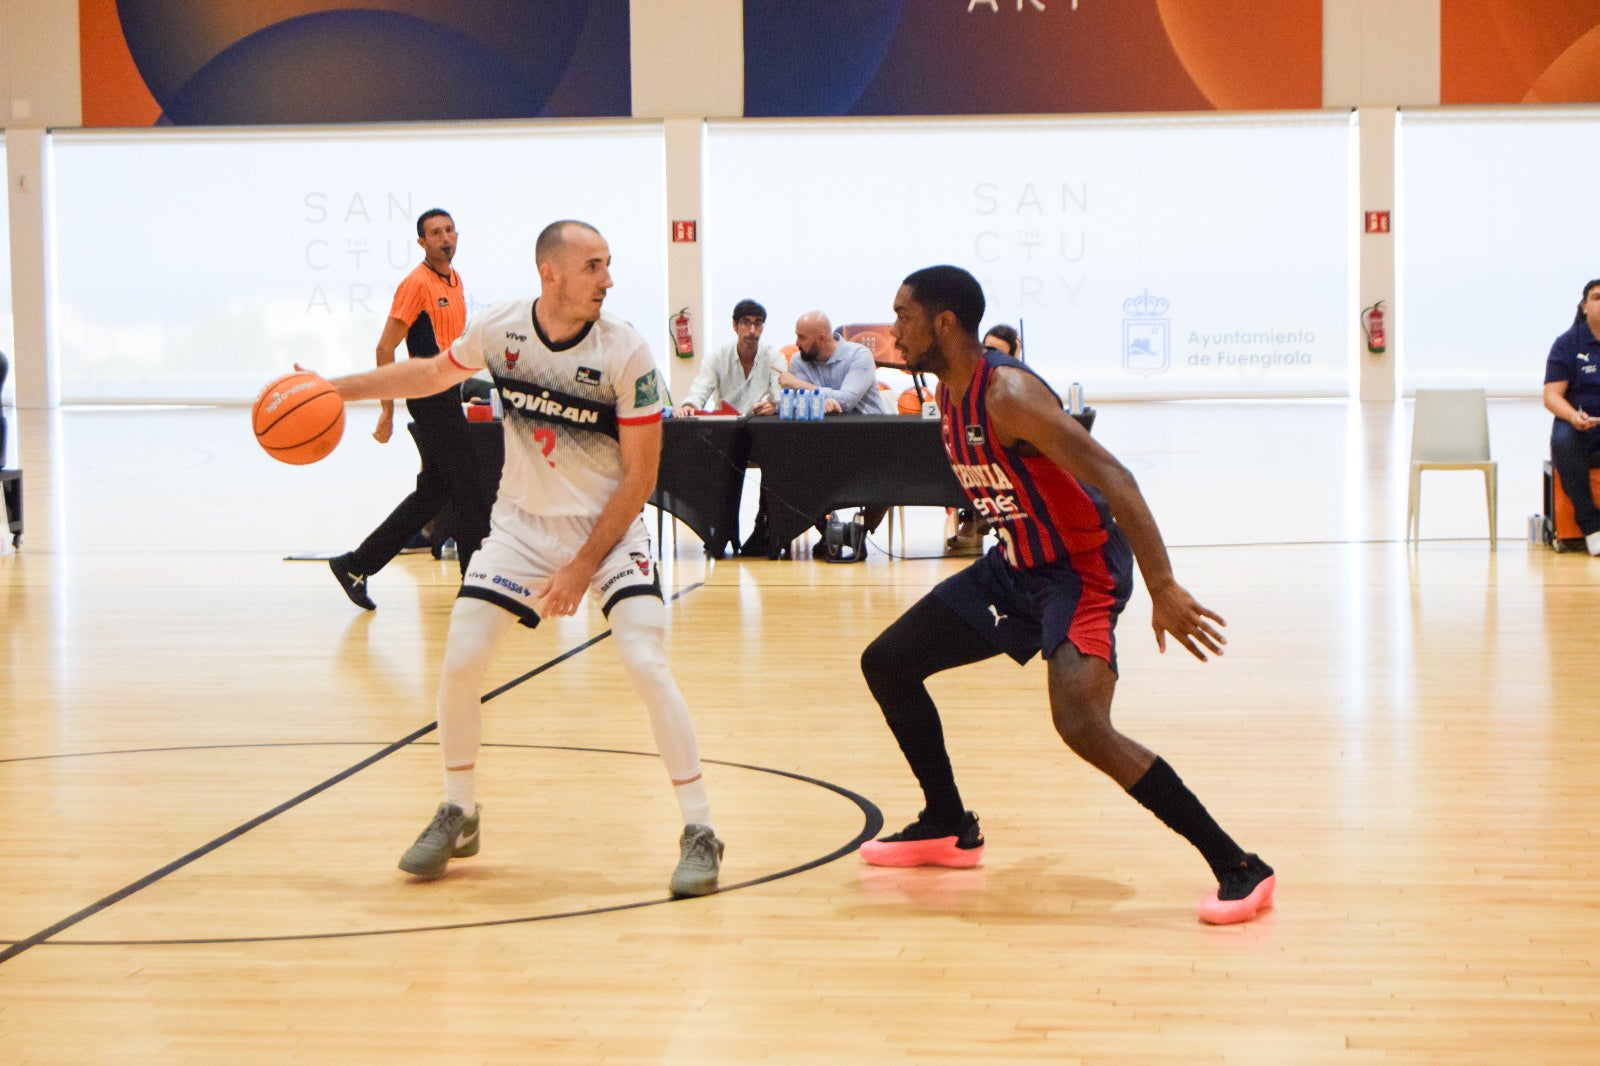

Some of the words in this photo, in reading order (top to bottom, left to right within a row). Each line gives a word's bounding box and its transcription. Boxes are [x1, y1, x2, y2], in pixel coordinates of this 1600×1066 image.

[304, 191, 413, 224] SAN
[973, 181, 1088, 215] SAN
[505, 331, 528, 342] vive
[1187, 328, 1316, 348] Ayuntamiento
[1187, 351, 1212, 366] de
[1217, 350, 1313, 369] Fuengirola
[928, 407, 937, 416] 2
